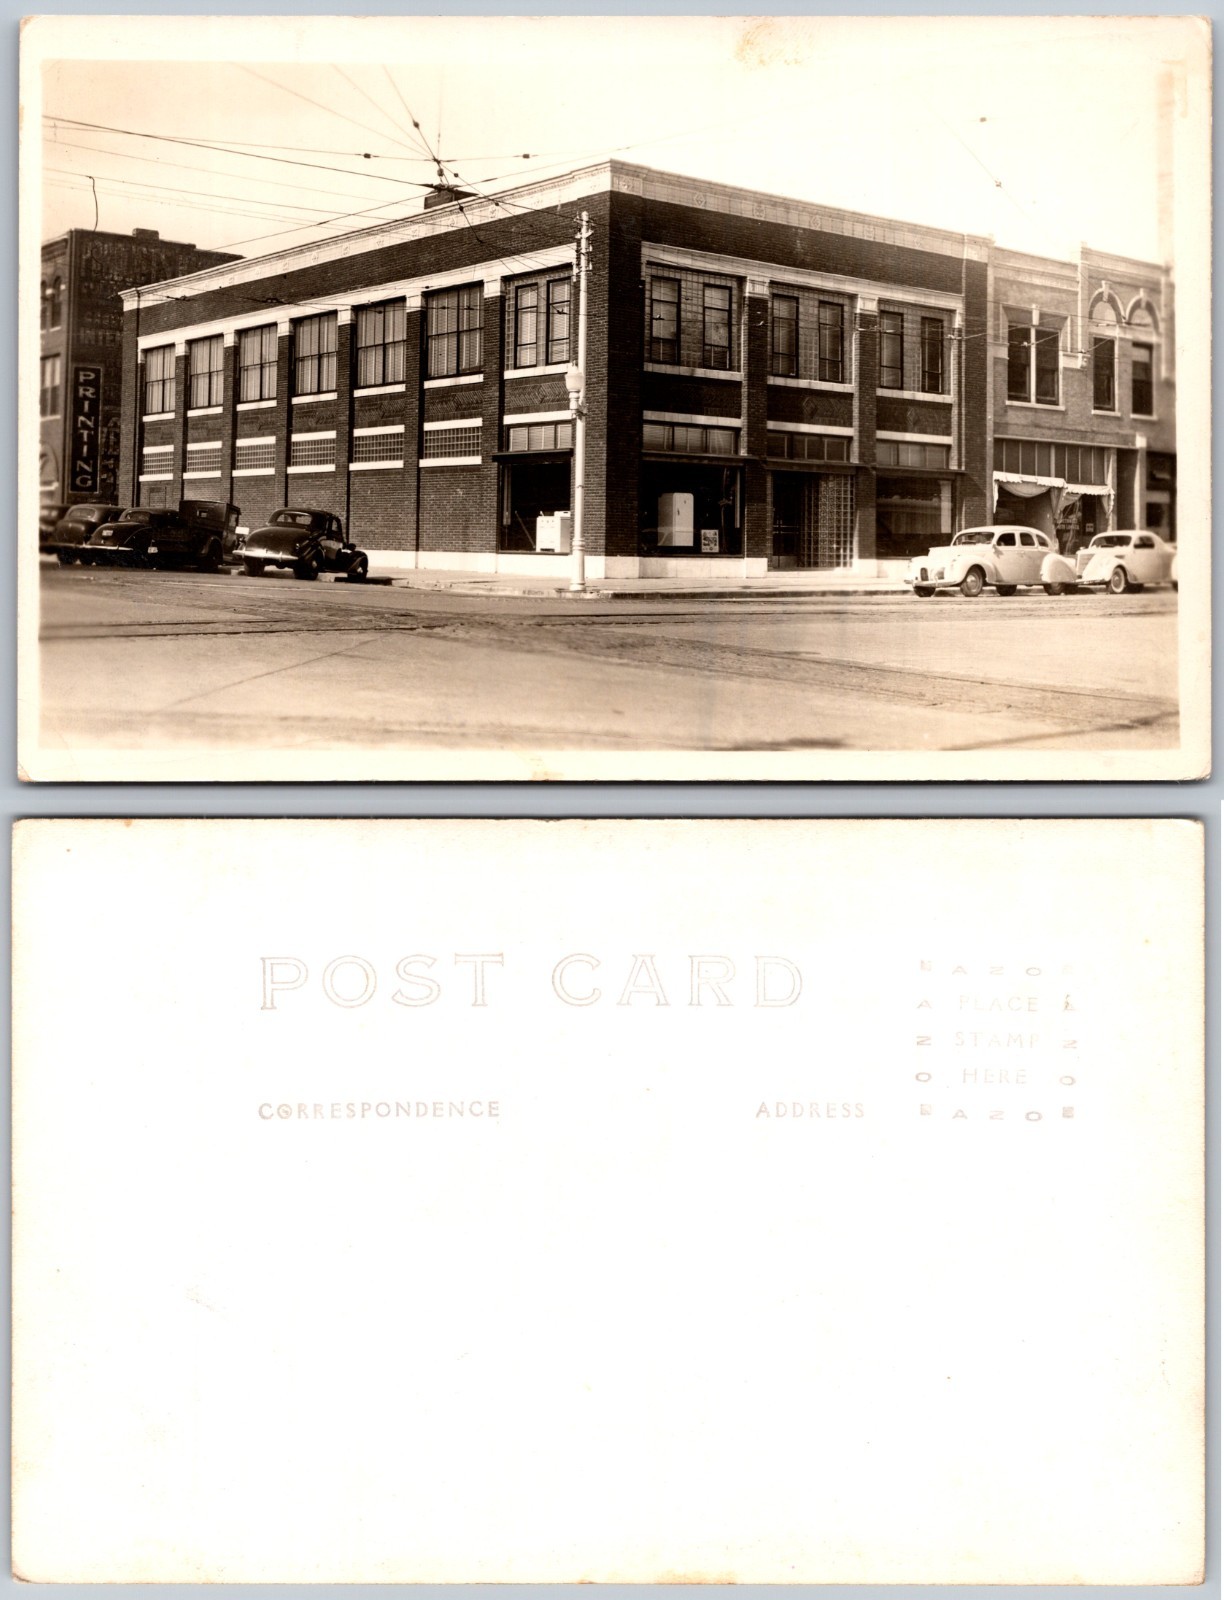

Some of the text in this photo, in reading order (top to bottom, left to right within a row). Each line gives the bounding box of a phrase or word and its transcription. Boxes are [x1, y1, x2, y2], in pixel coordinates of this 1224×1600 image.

[75, 371, 96, 488] PRINTING
[260, 953, 802, 1010] POST CARD
[959, 995, 1038, 1012] PLACE
[955, 1031, 1040, 1049] STAMP
[962, 1067, 1027, 1085] HERE
[258, 1101, 865, 1120] CORRESPONDENCE ADDRESS
